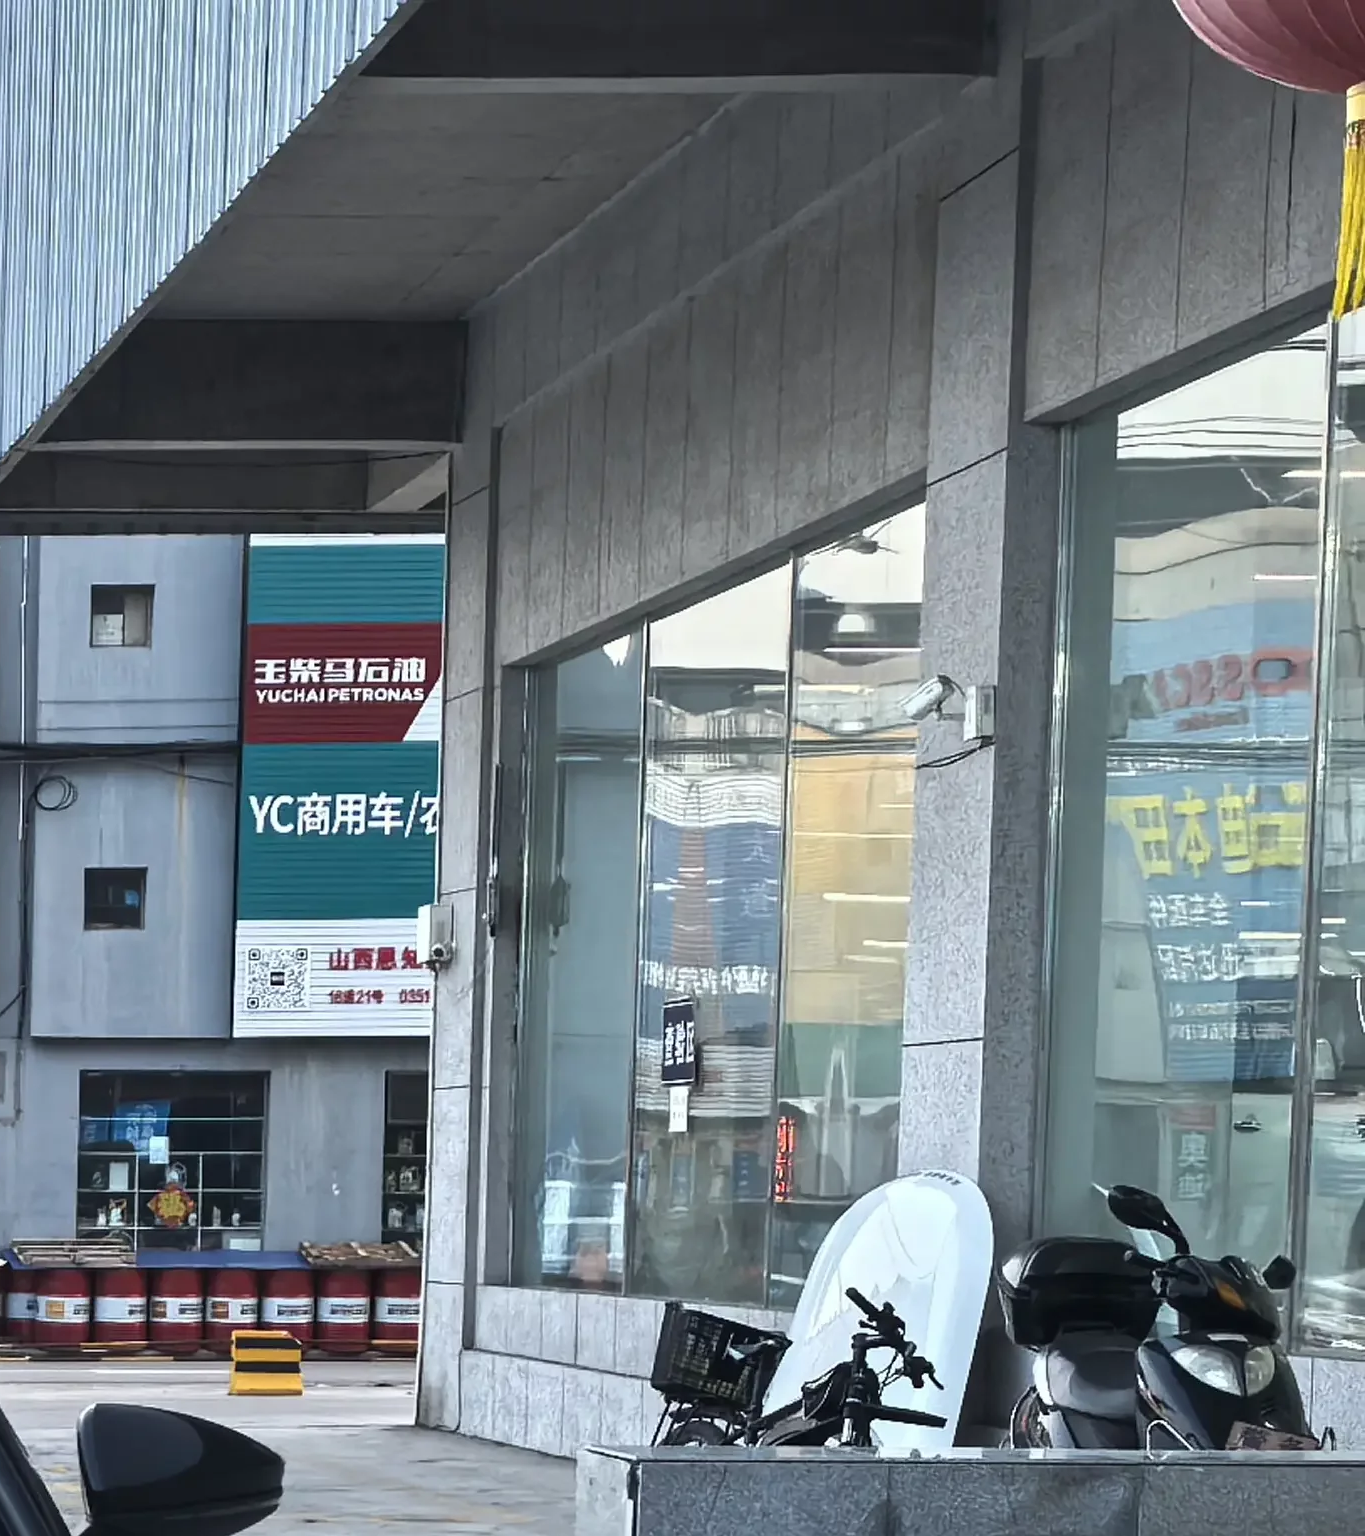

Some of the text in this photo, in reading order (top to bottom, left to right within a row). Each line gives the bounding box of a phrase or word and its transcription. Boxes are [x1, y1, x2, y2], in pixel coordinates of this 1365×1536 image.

[254, 657, 426, 685] 玉柴马石油
[255, 687, 425, 704] YUCHAI PETRONAS
